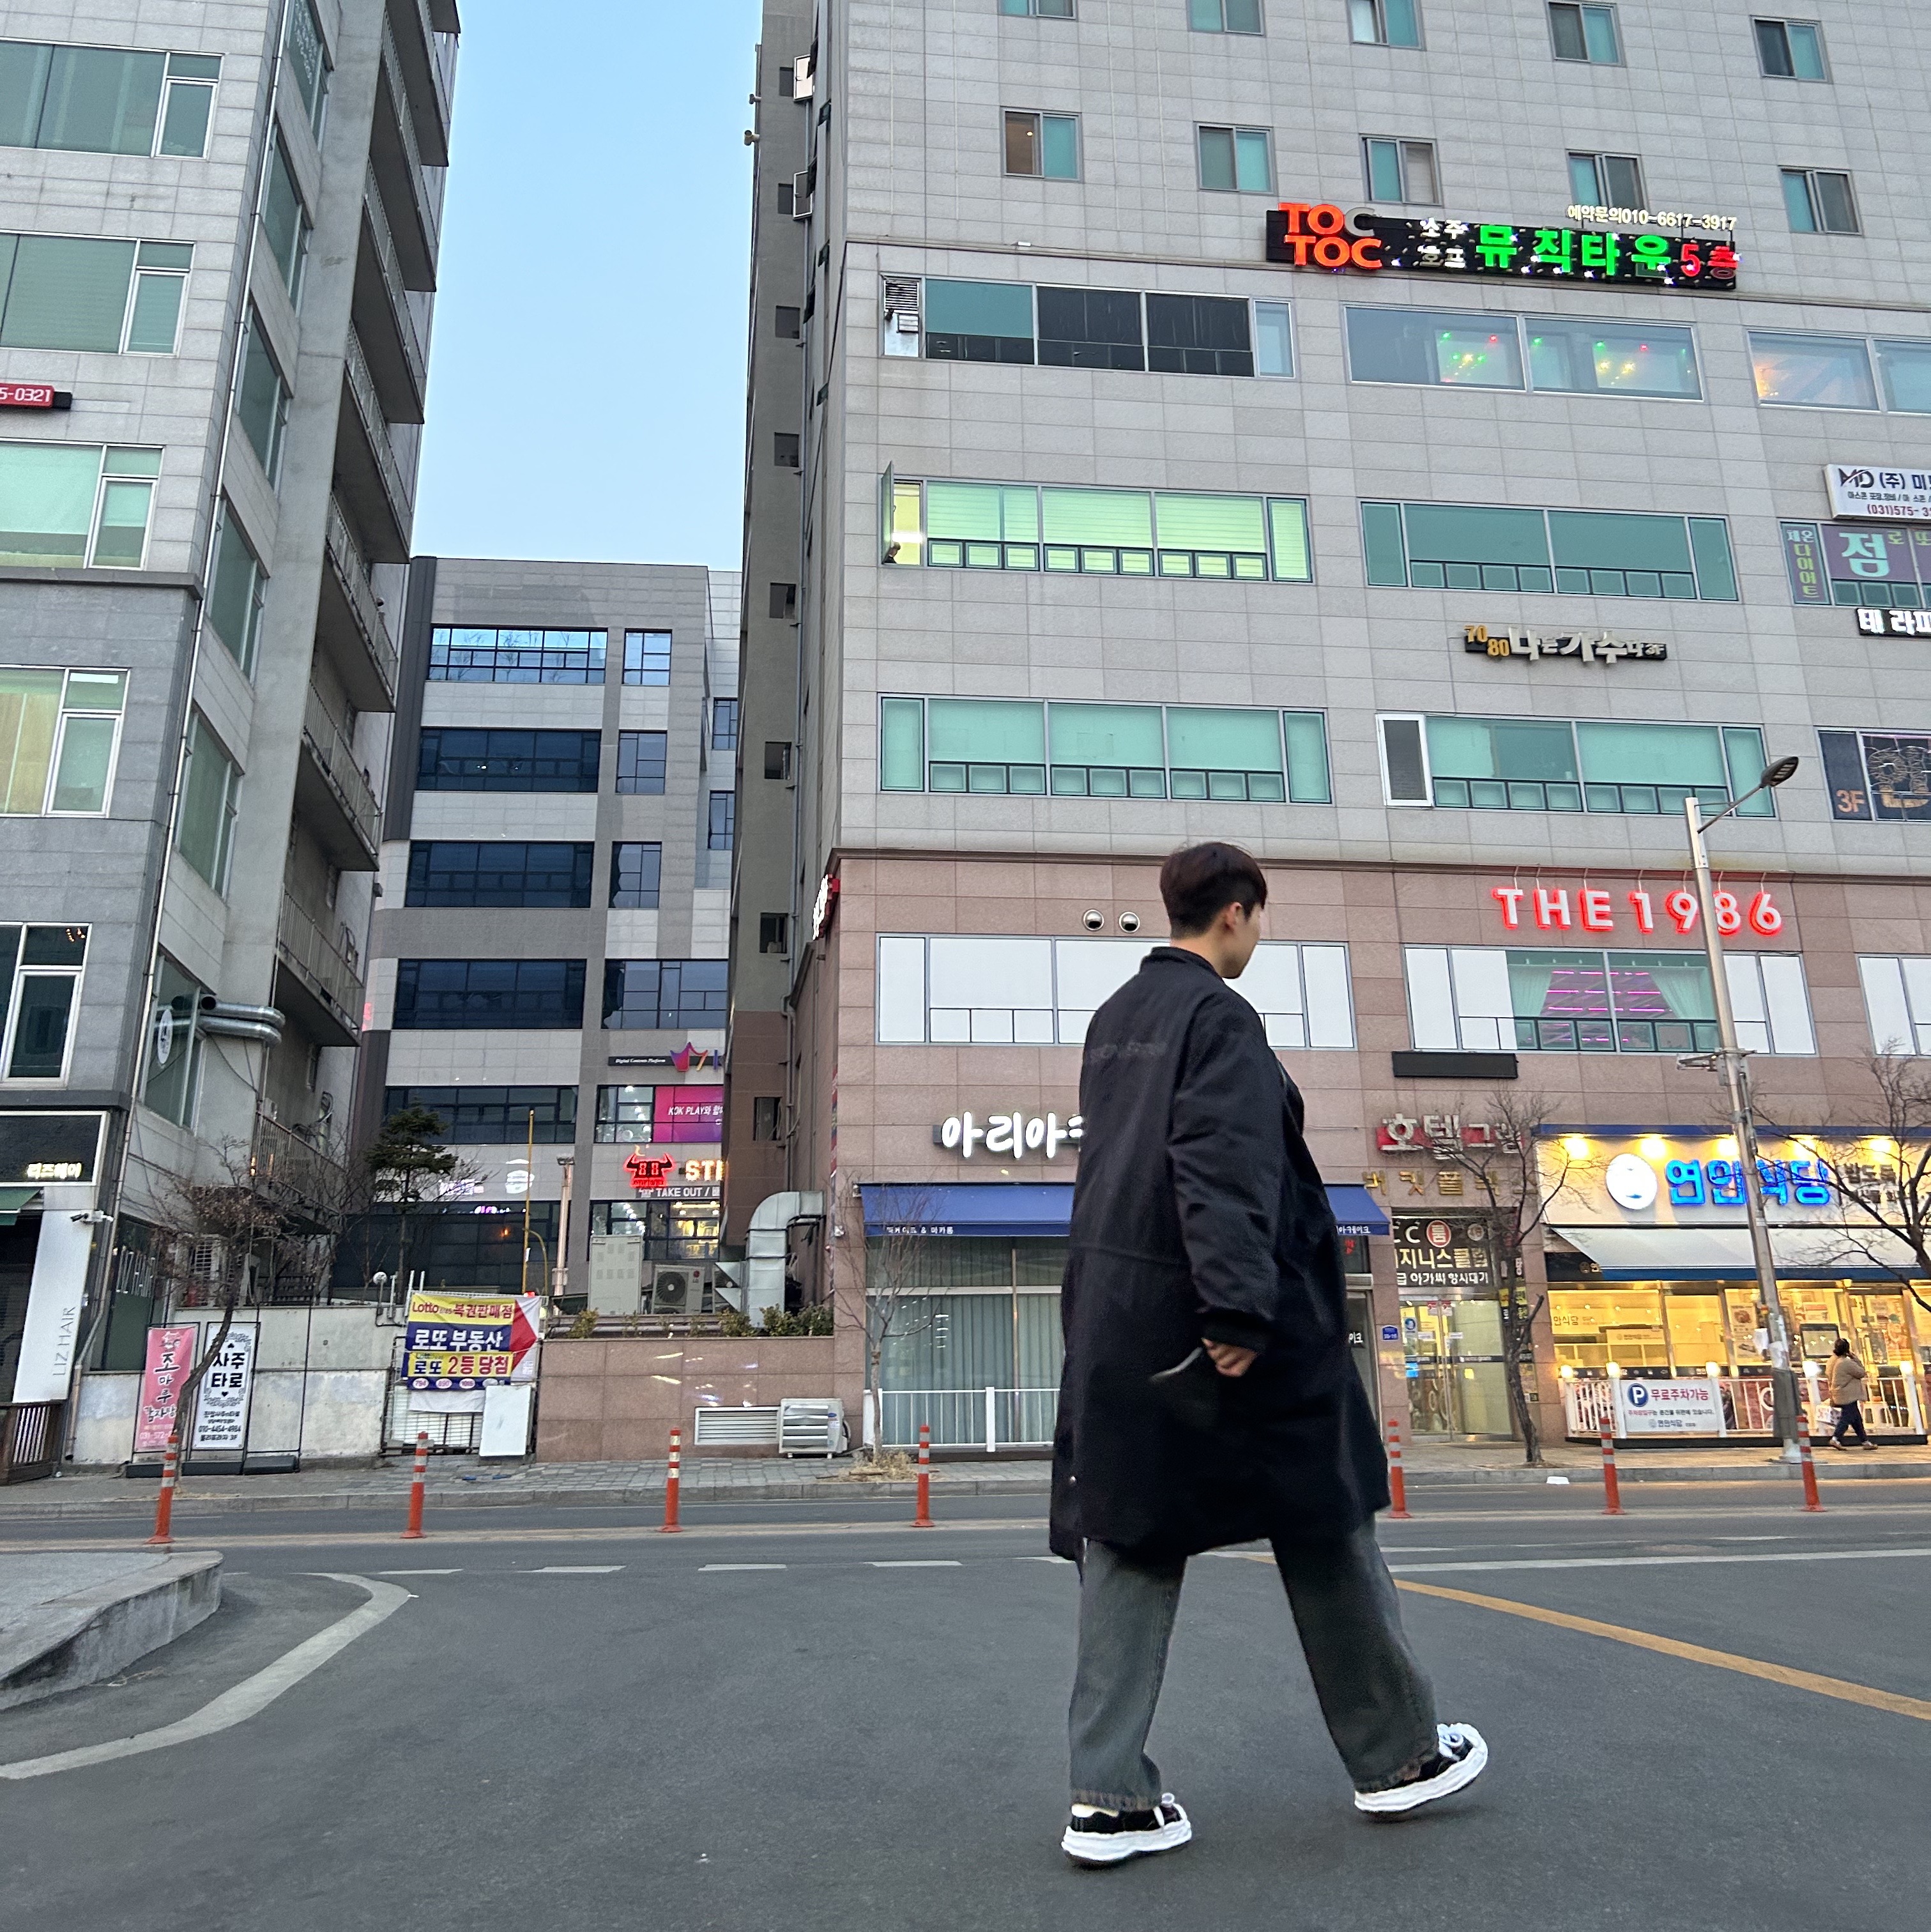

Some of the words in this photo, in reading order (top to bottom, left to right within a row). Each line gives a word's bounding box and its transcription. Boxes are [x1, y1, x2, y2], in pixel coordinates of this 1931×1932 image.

[1278, 203, 1375, 237] TOC
[1285, 234, 1383, 270] TOC
[1911, 474, 1931, 490] 미
[1464, 625, 1488, 643] 70
[1488, 639, 1509, 656] 80
[1836, 790, 1865, 812] 3F
[1493, 889, 1614, 931] THE
[1630, 890, 1782, 935] 1986
[656, 1188, 681, 1197] TAKE
[683, 1188, 702, 1197] OUT
[1666, 1159, 1830, 1206] 연안식당
[412, 1302, 439, 1313] Lotto
[454, 1303, 512, 1319] 복권판매점
[57, 1307, 75, 1346] HAIR
[412, 1330, 447, 1350] 로또
[450, 1330, 503, 1351] 부동산
[213, 1353, 245, 1369] 사주
[414, 1361, 442, 1374] 로또
[447, 1356, 475, 1375] 2등
[479, 1356, 508, 1375] 당첨
[211, 1372, 243, 1388] 타로
[1651, 1388, 1709, 1401] 무료주차가능
